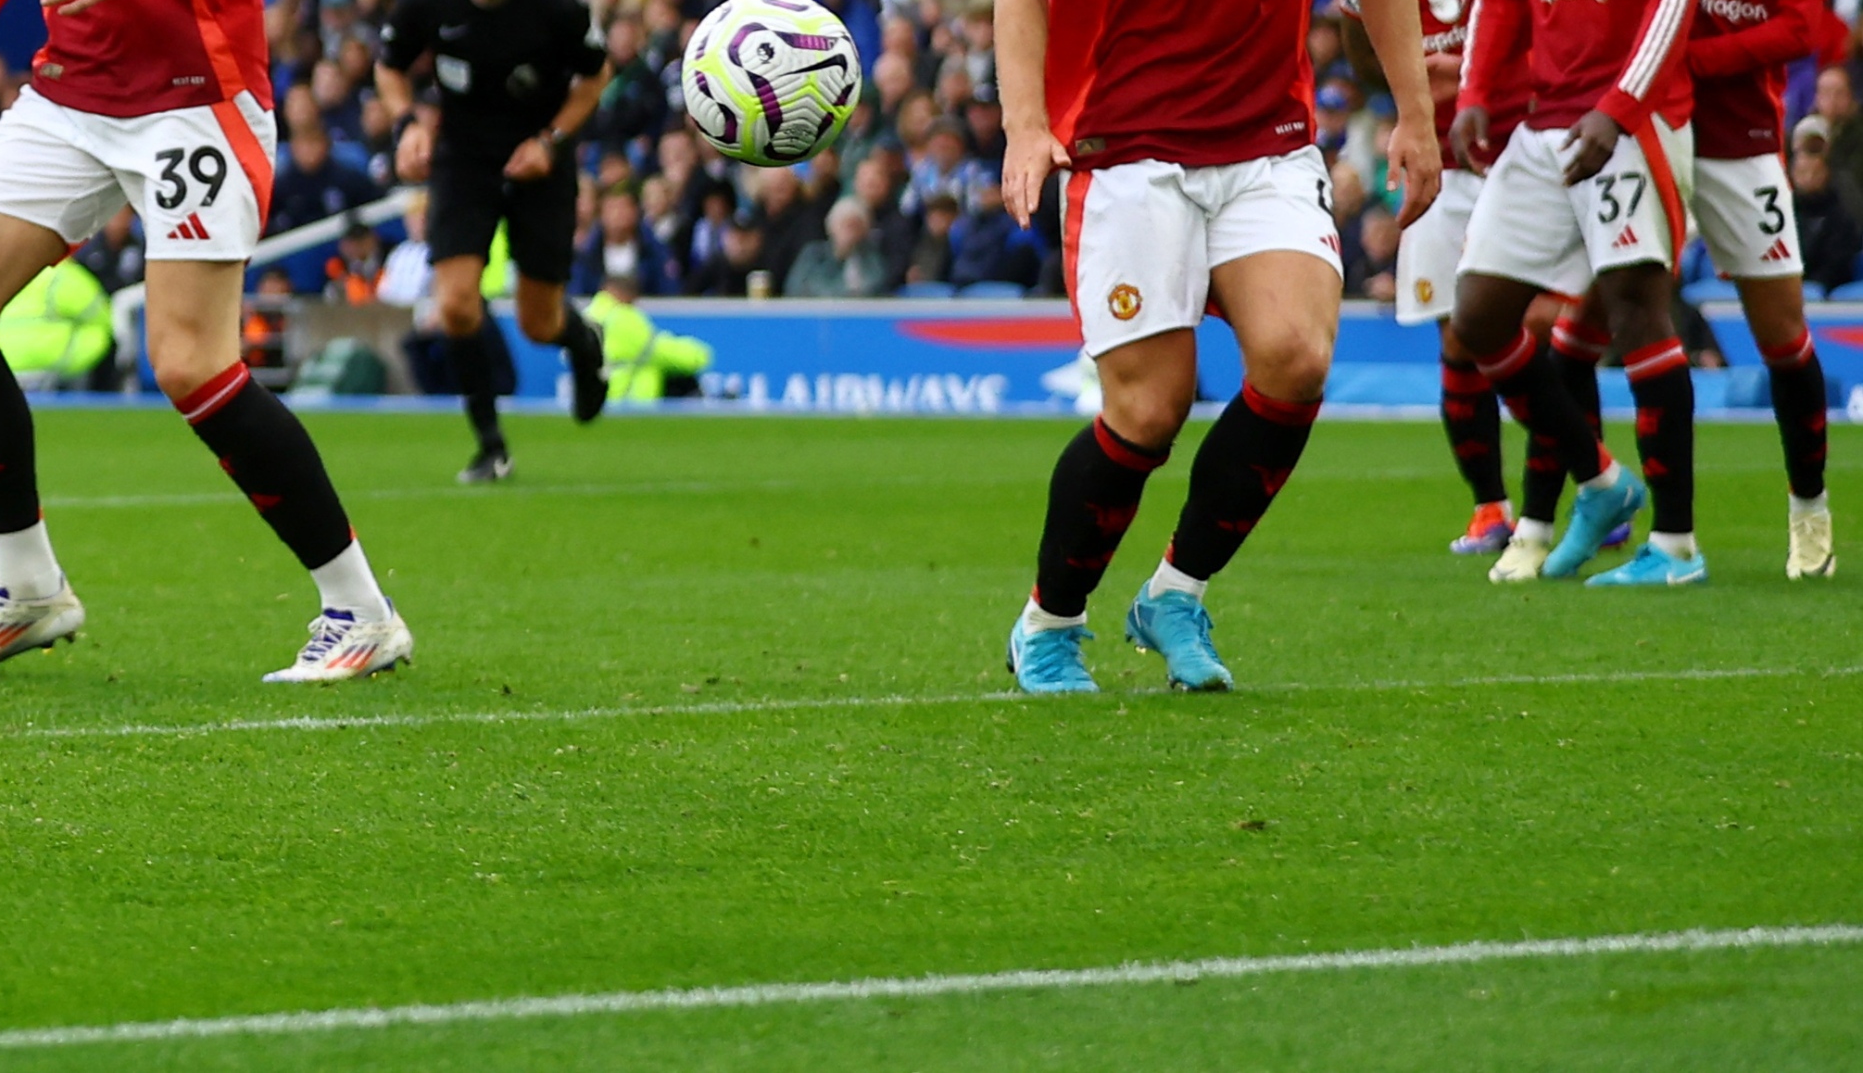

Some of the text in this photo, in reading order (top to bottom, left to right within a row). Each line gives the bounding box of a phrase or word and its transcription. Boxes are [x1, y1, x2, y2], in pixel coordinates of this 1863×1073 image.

[155, 145, 227, 209] 39
[1595, 172, 1646, 223] 37
[1753, 185, 1785, 235] 3
